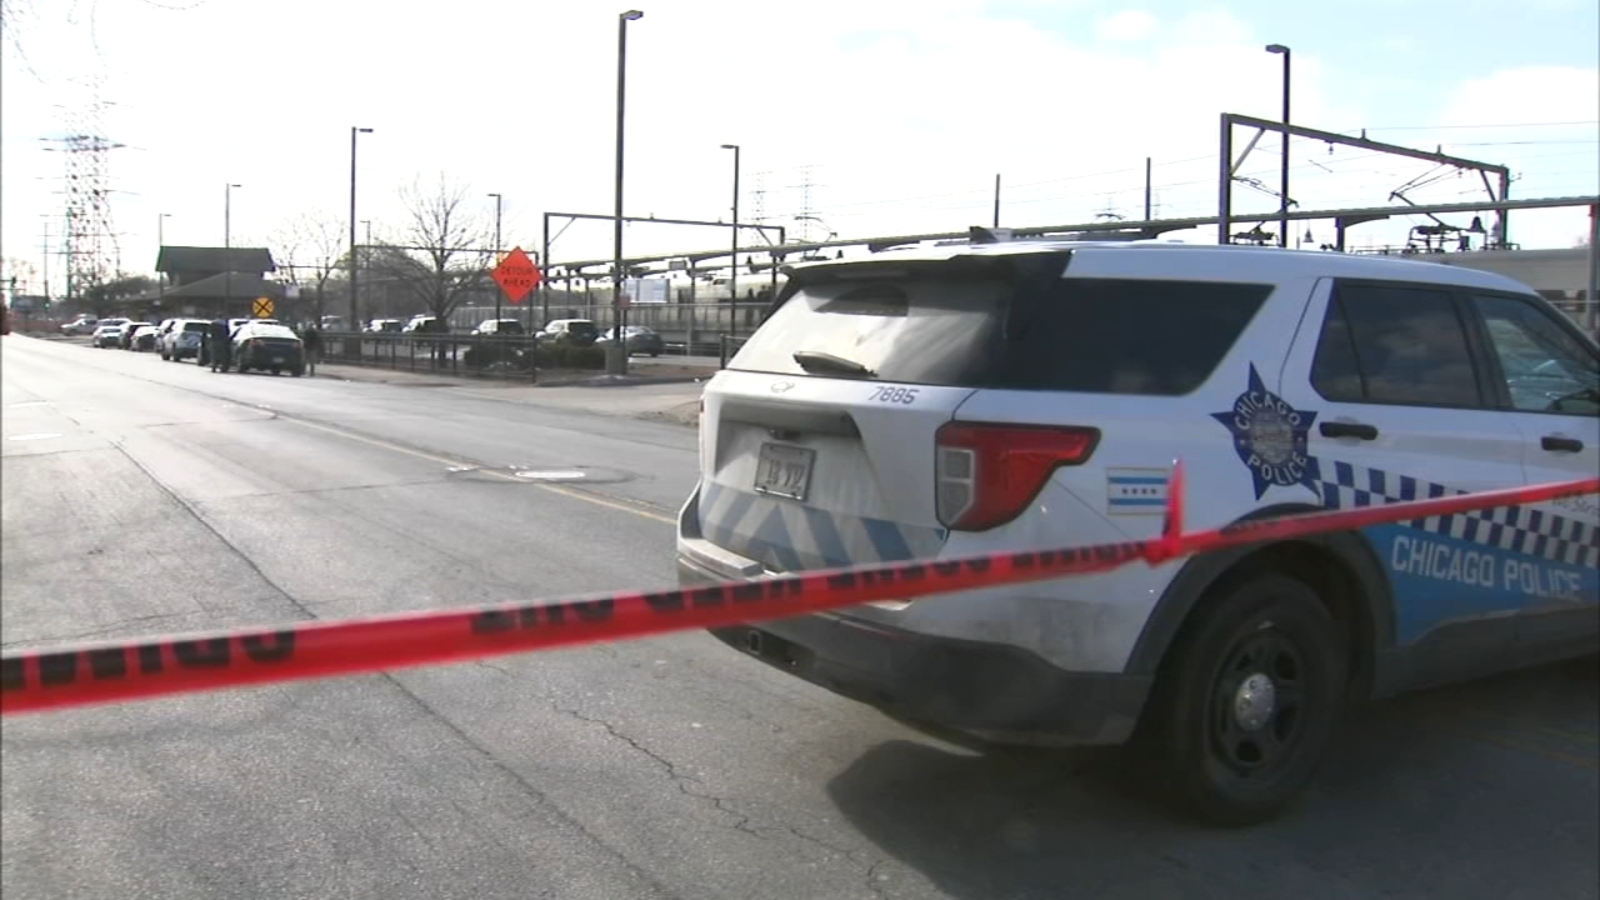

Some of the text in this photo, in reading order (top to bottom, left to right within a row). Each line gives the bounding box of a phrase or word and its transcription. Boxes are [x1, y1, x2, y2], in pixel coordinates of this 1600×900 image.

[501, 265, 533, 276] DETOUR
[503, 277, 531, 289] AHEAD
[868, 386, 920, 405] 7885
[1234, 391, 1301, 430] CHICAGO
[1247, 451, 1308, 485] POLICE
[1391, 534, 1582, 601] CHICAGO POLICE
